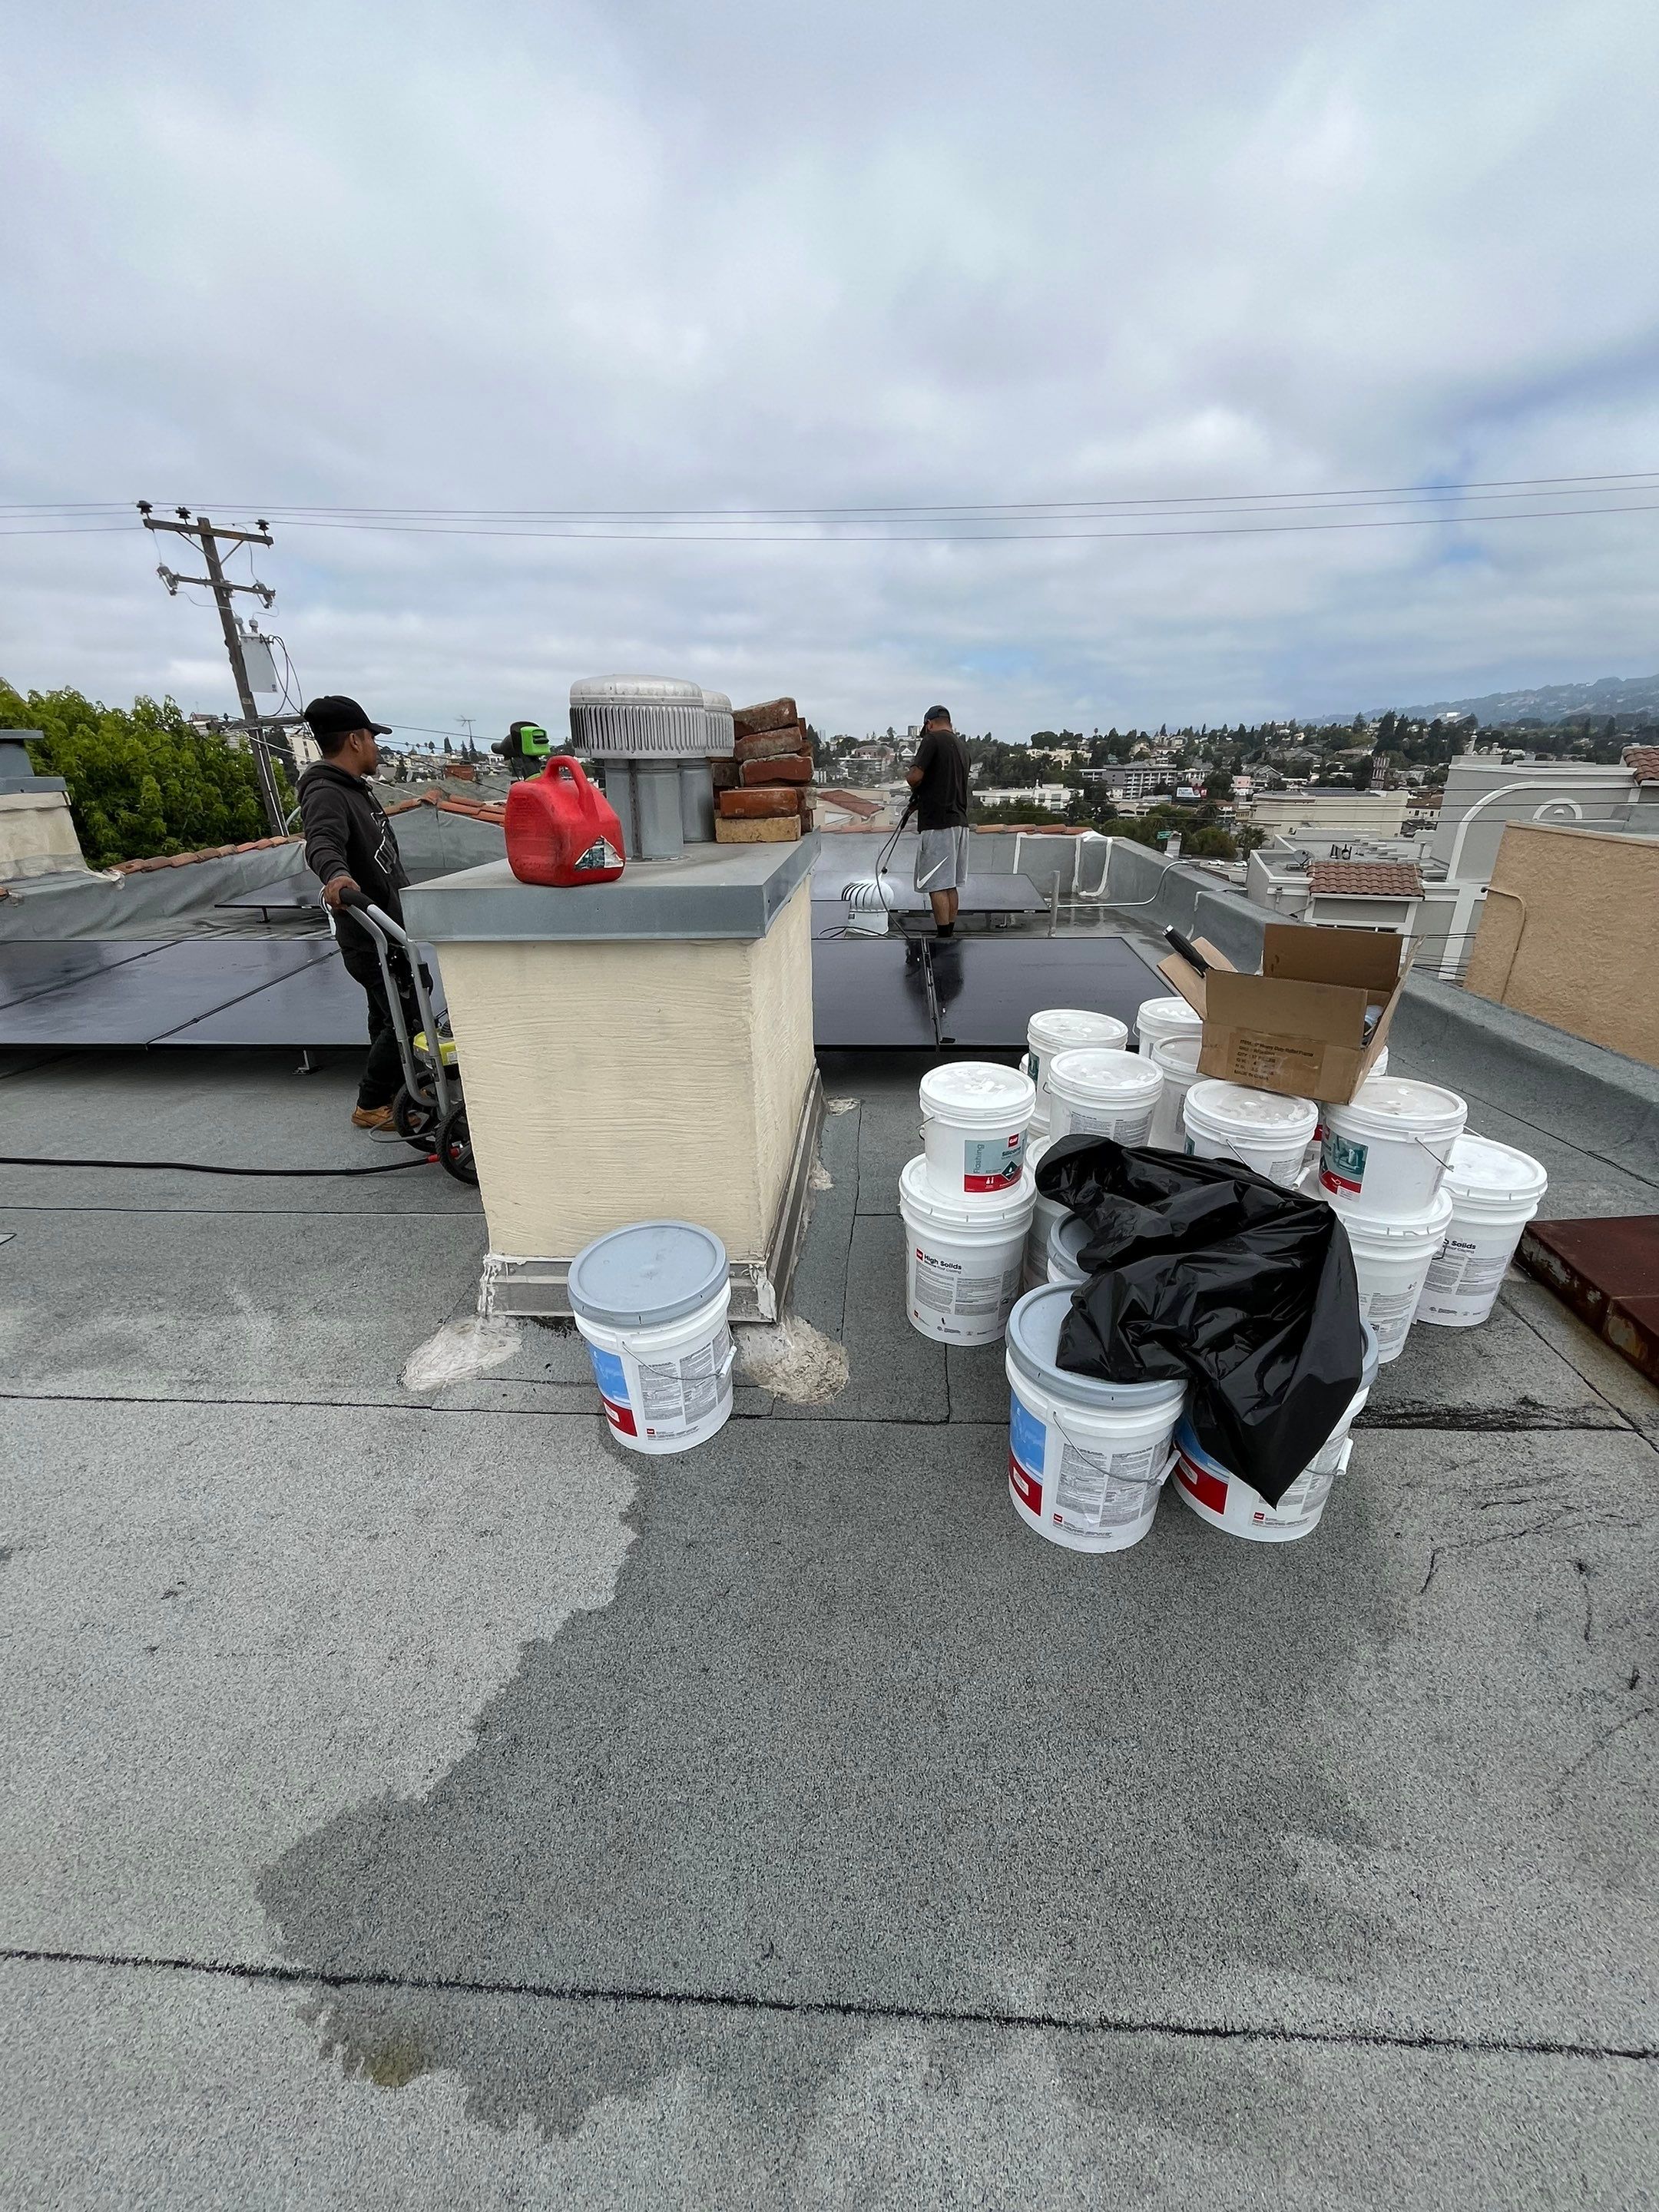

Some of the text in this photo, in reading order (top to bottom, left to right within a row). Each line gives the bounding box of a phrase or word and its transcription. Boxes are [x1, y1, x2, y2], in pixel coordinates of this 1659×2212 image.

[973, 1144, 985, 1174] Flashing
[1451, 1240, 1476, 1250] Solids
[924, 1253, 939, 1265] High
[940, 1260, 962, 1270] Solids
